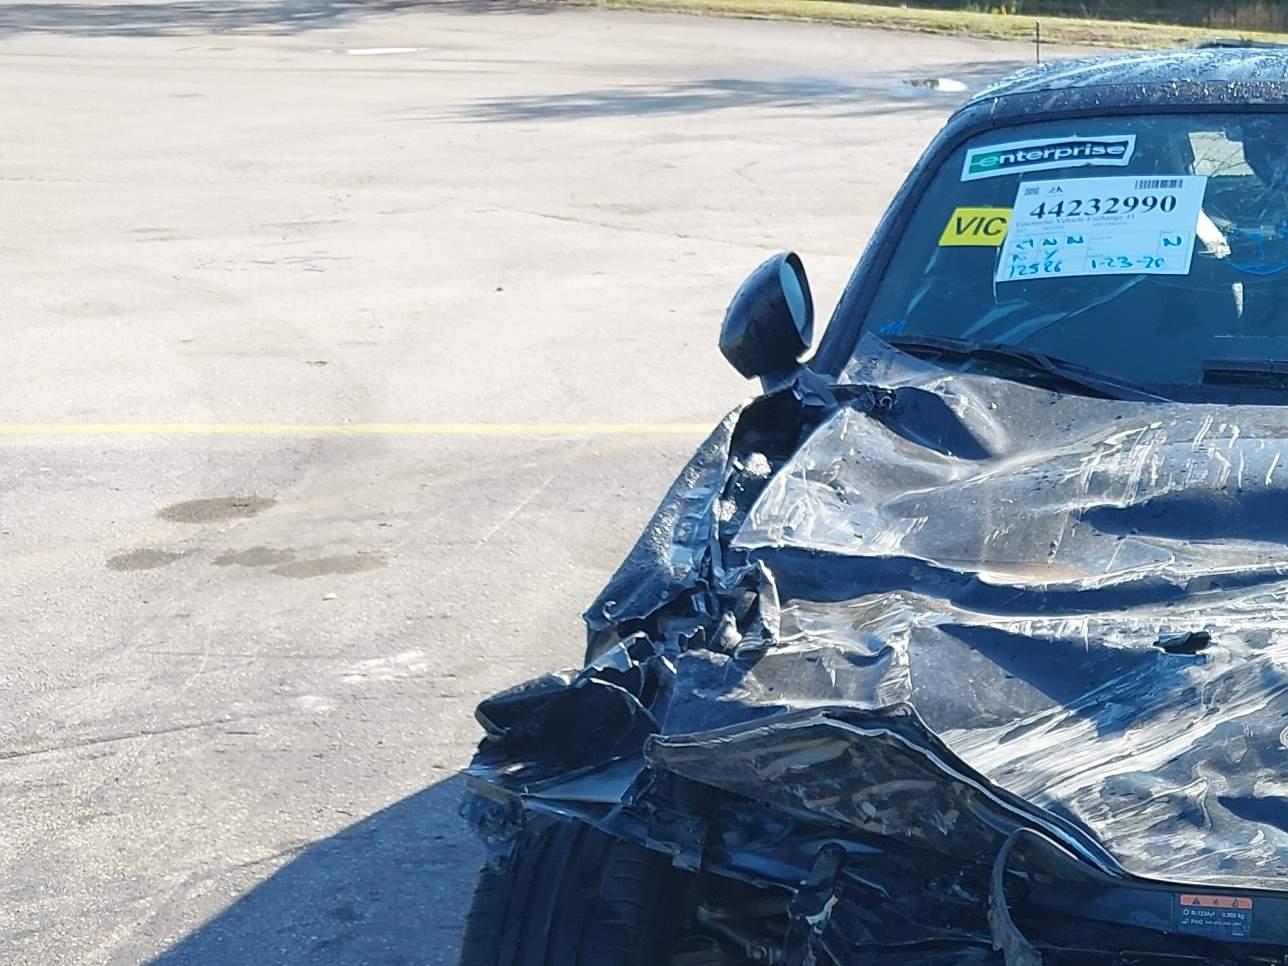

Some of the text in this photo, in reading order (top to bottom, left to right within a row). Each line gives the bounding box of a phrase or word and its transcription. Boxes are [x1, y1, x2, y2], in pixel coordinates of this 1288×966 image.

[971, 143, 1126, 167] enterprise
[1029, 195, 1177, 219] 44232990
[955, 216, 1007, 236] VIC
